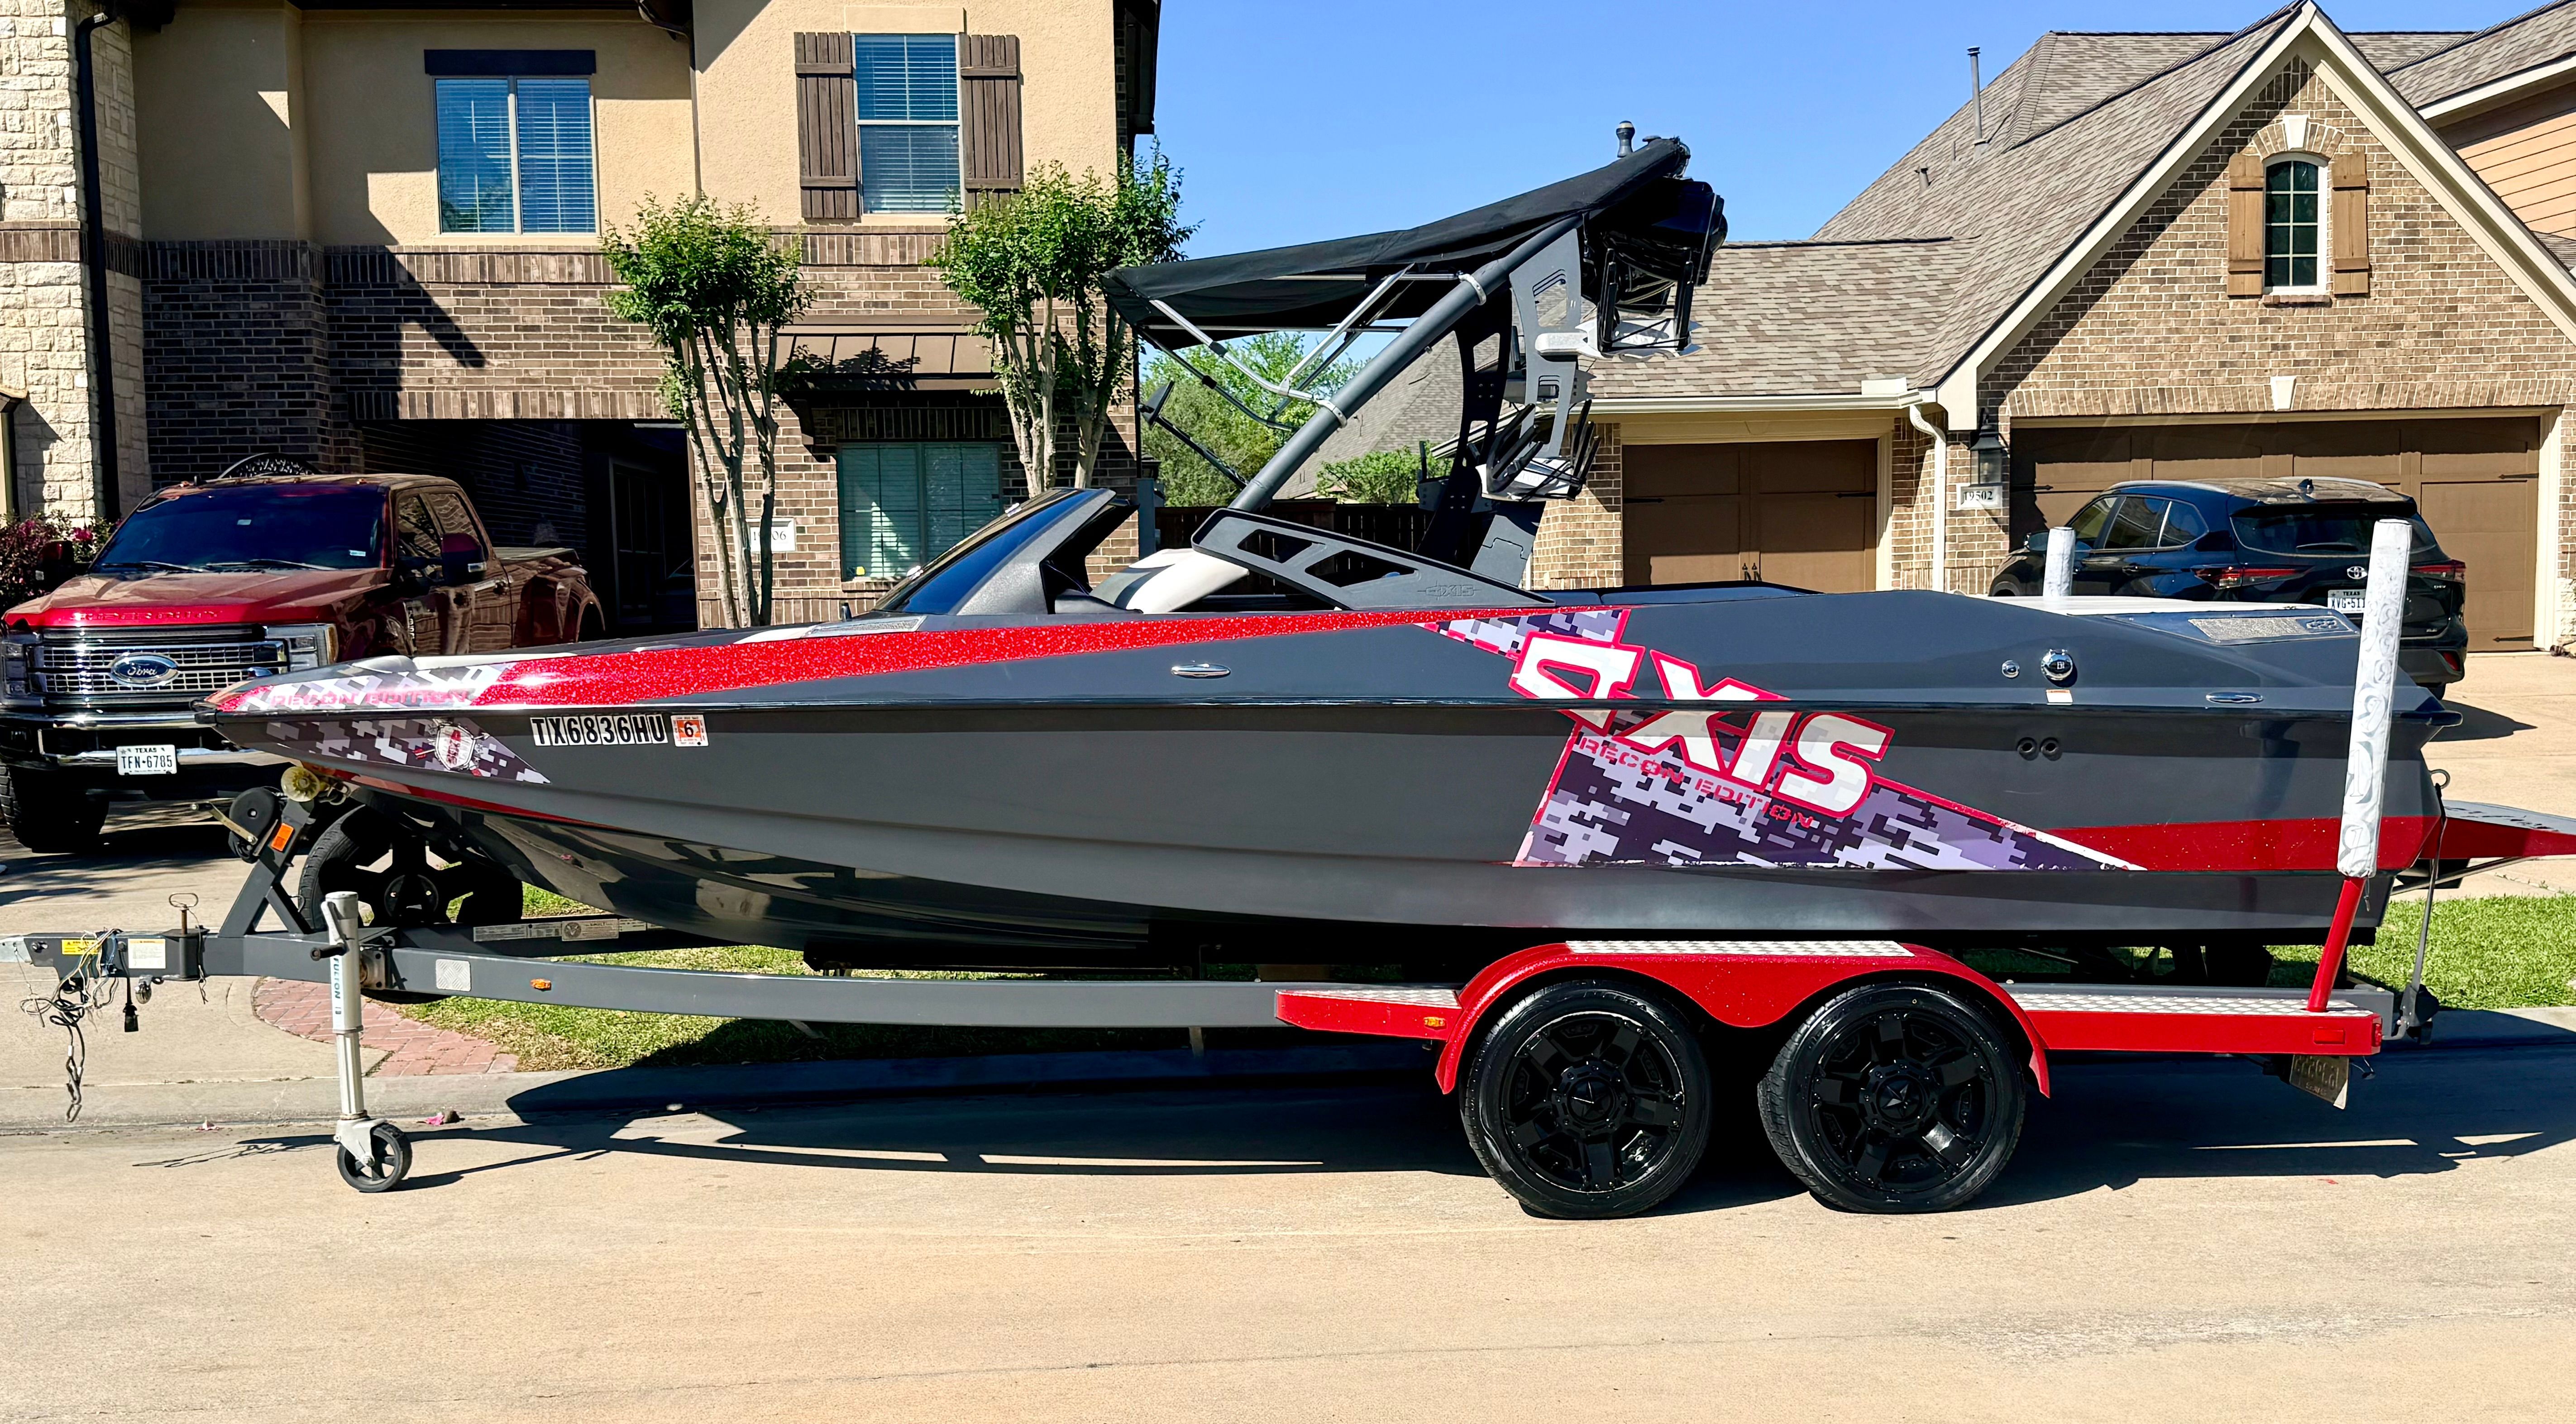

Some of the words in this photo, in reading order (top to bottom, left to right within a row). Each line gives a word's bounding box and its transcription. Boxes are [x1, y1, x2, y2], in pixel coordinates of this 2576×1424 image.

[1963, 491, 1993, 501] 19502
[127, 662, 158, 676] Ford
[271, 691, 359, 706] RECON
[364, 689, 467, 705] EDITION
[532, 717, 665, 744] TX6836HU
[684, 721, 694, 737] 6
[1579, 737, 1684, 784] RECON
[1695, 778, 1814, 829] EDITION
